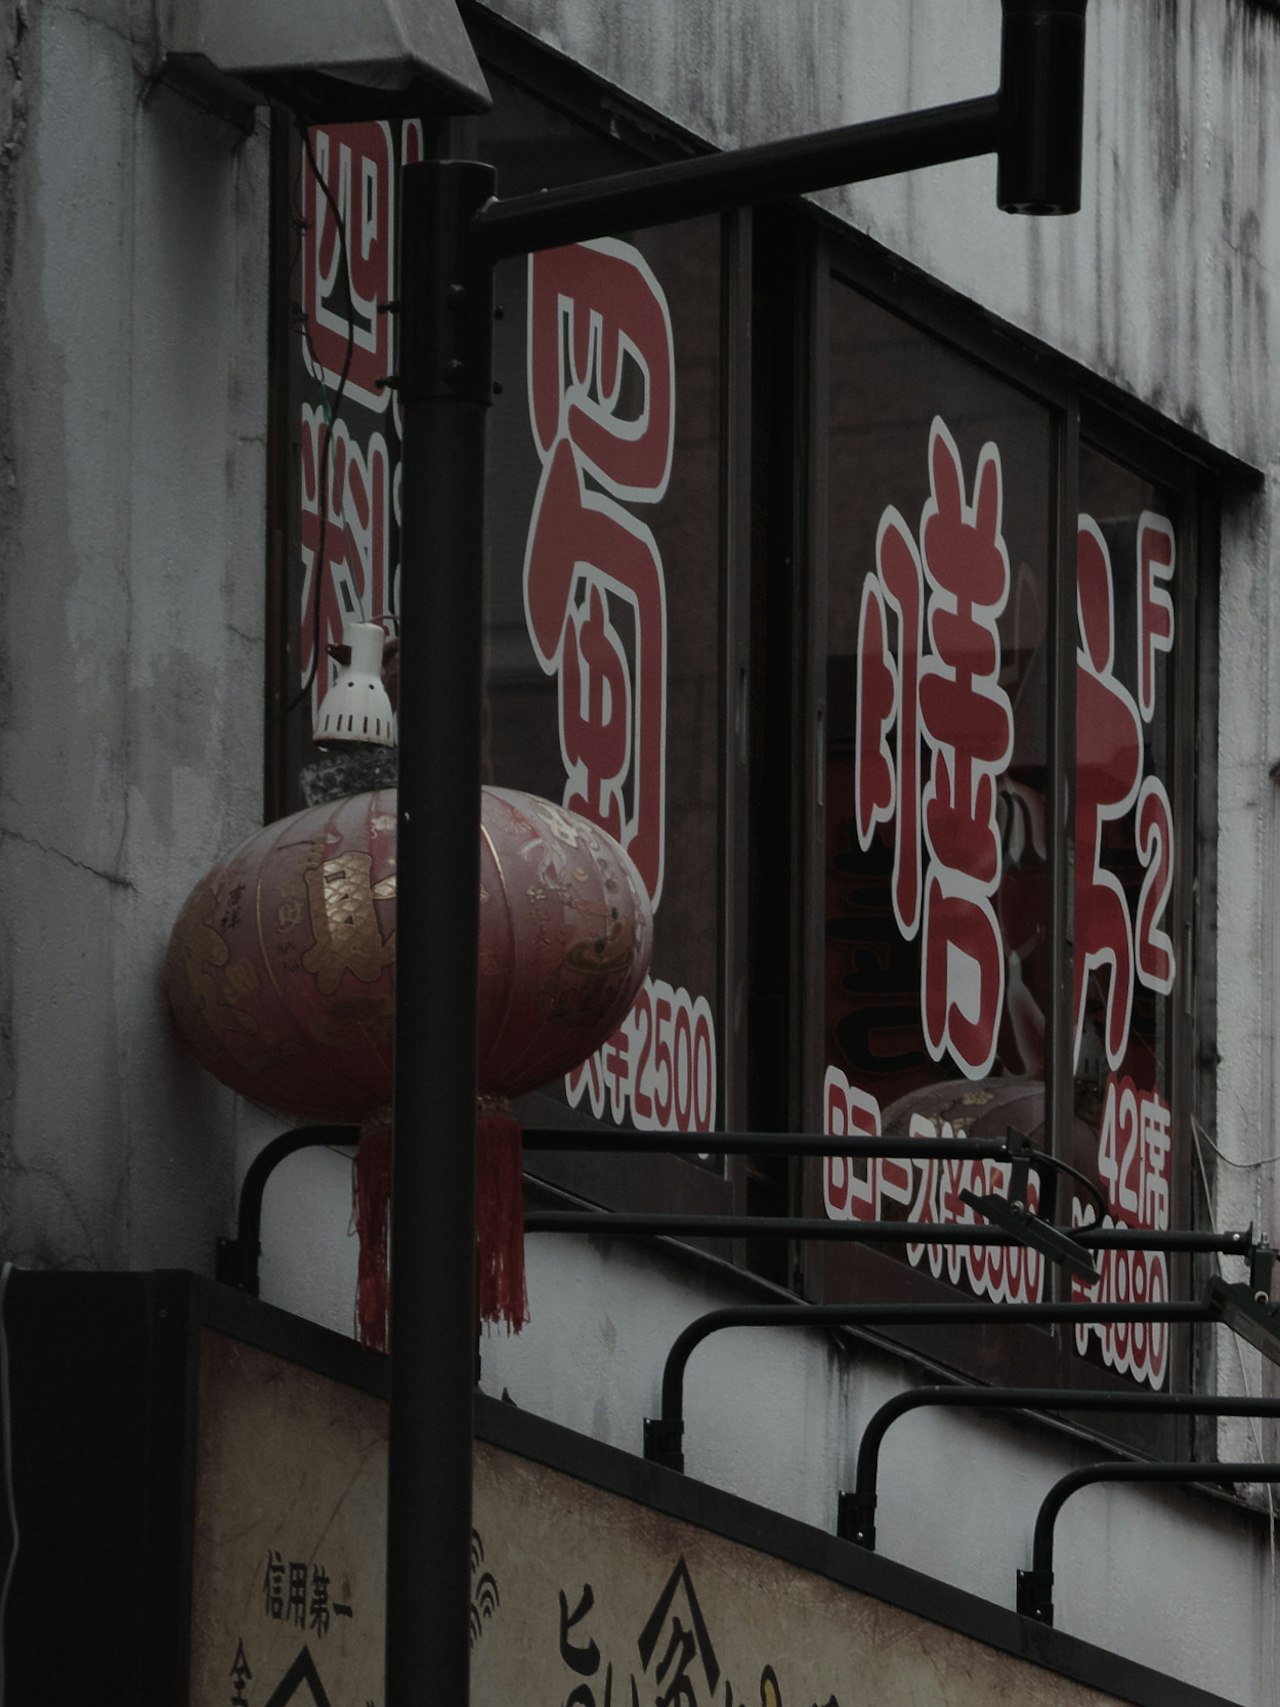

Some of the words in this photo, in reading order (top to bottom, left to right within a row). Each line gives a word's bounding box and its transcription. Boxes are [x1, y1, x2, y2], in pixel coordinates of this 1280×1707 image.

[1099, 1072, 1172, 1232] 42席
[262, 1549, 353, 1639] 信用第一
